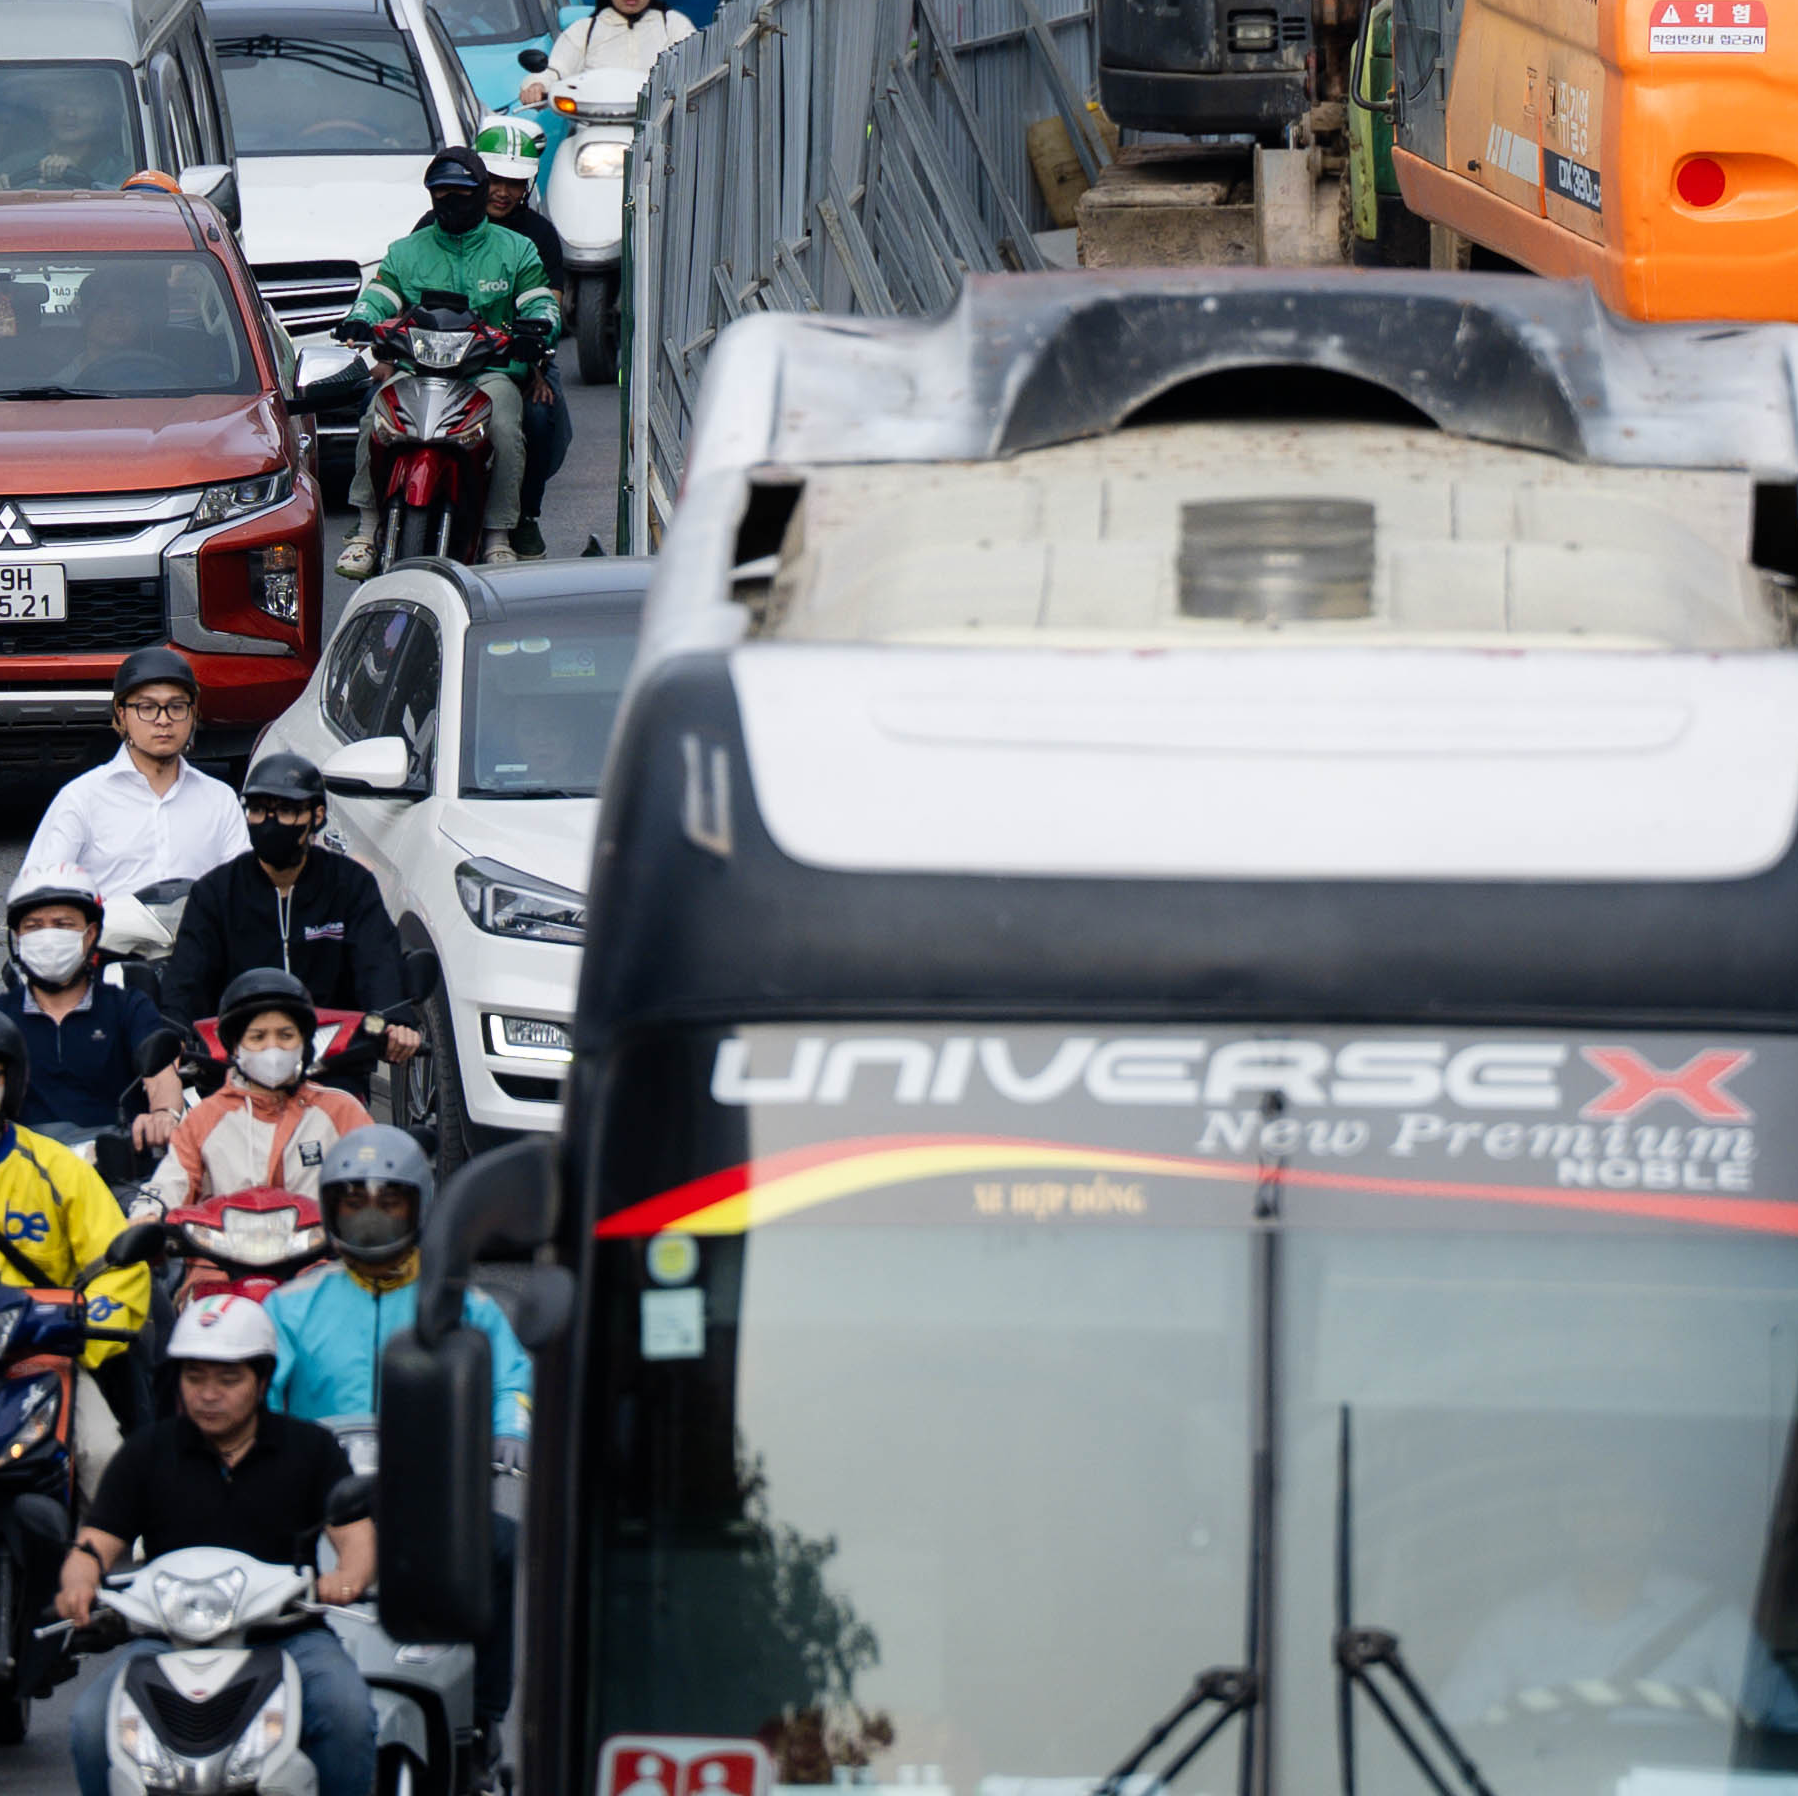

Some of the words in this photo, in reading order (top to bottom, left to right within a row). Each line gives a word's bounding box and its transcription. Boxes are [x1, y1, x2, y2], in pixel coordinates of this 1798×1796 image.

[477, 277, 510, 293] Grab
[1197, 1109, 1370, 1157] New
[1388, 1112, 1760, 1164] Premium
[1556, 1157, 1754, 1192] NOBLE
[4, 1199, 51, 1242] be
